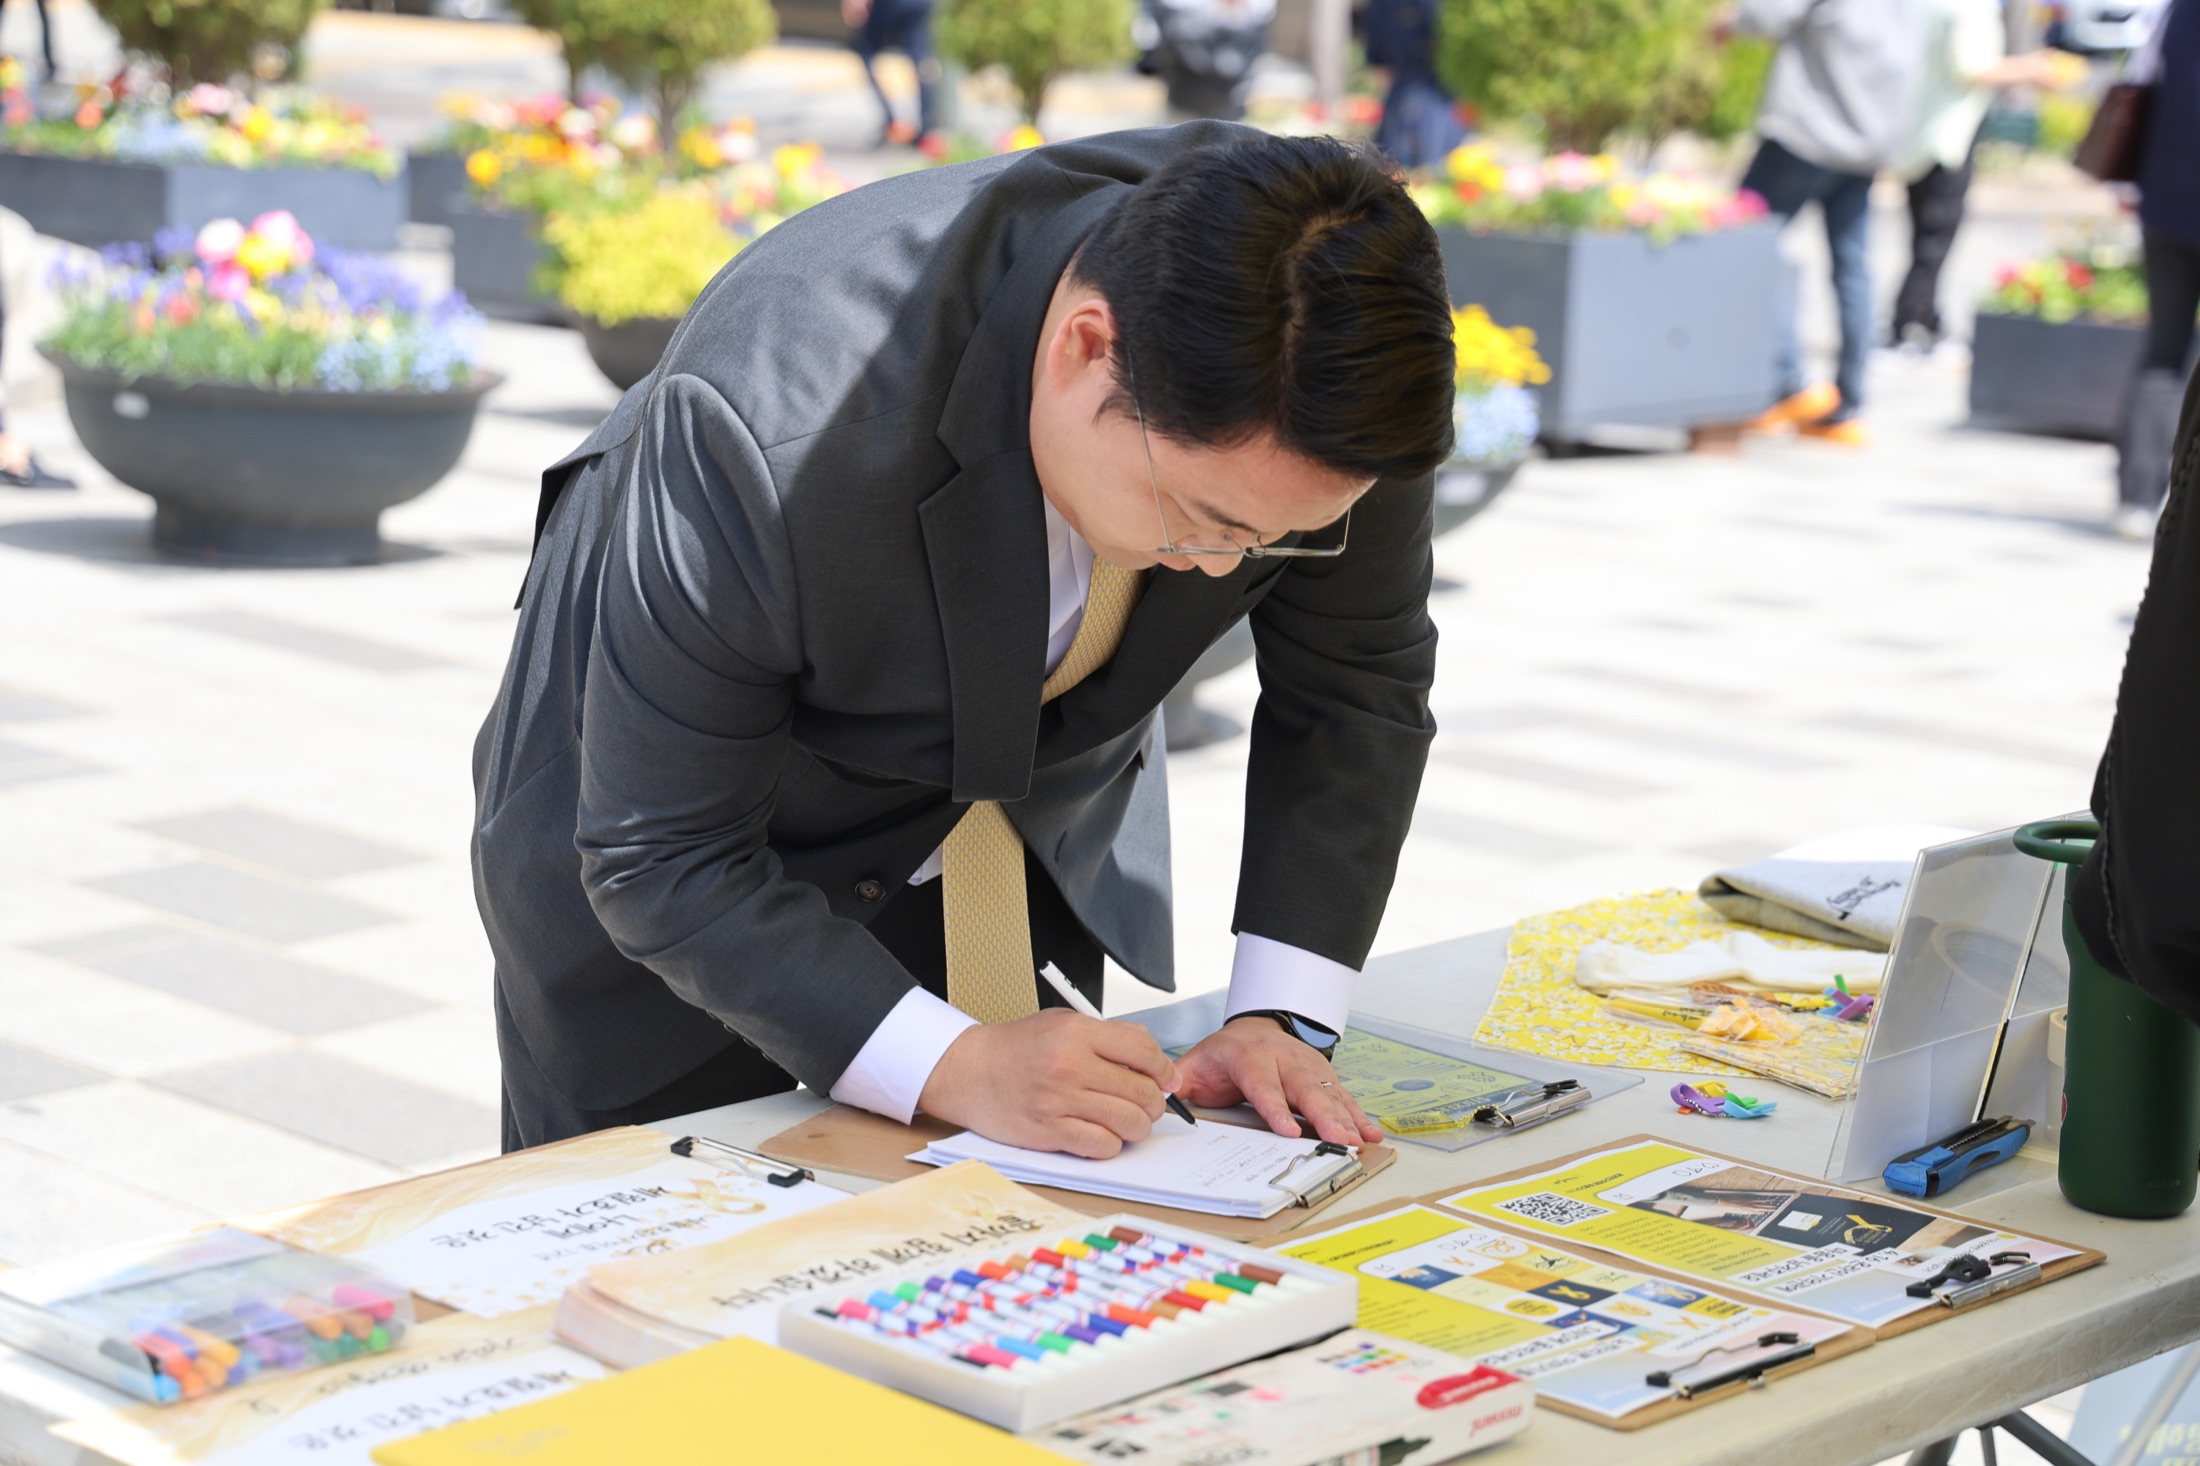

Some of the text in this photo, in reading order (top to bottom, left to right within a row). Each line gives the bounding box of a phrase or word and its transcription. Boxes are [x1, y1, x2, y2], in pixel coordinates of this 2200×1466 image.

[430, 1186, 672, 1249] 세월호가 남긴 것은
[541, 1213, 640, 1239] 나에게
[711, 1212, 1045, 1311] 끝까지 함께 하겠습니다
[1801, 1245, 1852, 1264] 마음을
[1863, 1249, 1902, 1266] 4.16
[442, 1369, 575, 1408] 세월호가
[364, 1401, 444, 1430] 남긴
[287, 1422, 368, 1451] 것은
